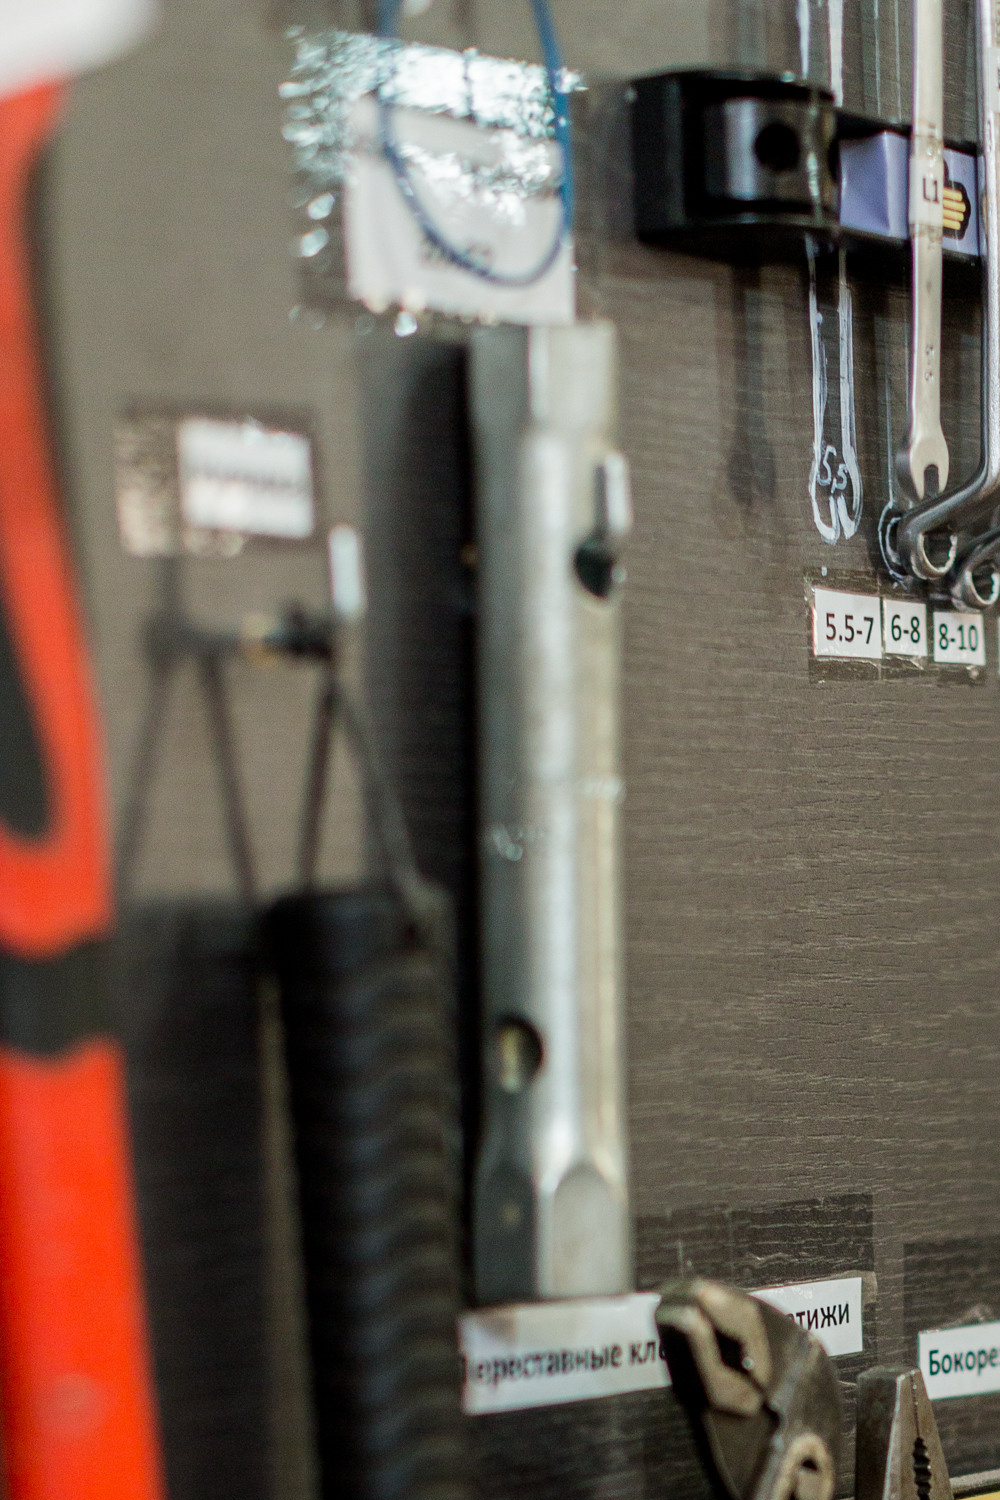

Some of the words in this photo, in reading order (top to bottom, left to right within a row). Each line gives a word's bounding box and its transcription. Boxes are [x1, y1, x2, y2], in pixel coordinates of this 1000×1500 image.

[922, 177, 939, 203] L1
[825, 611, 875, 645] 5.5-7
[890, 614, 921, 644] 6-8
[938, 623, 979, 652] 8-10
[787, 1303, 849, 1331] тижи
[465, 1343, 623, 1391] ереставные
